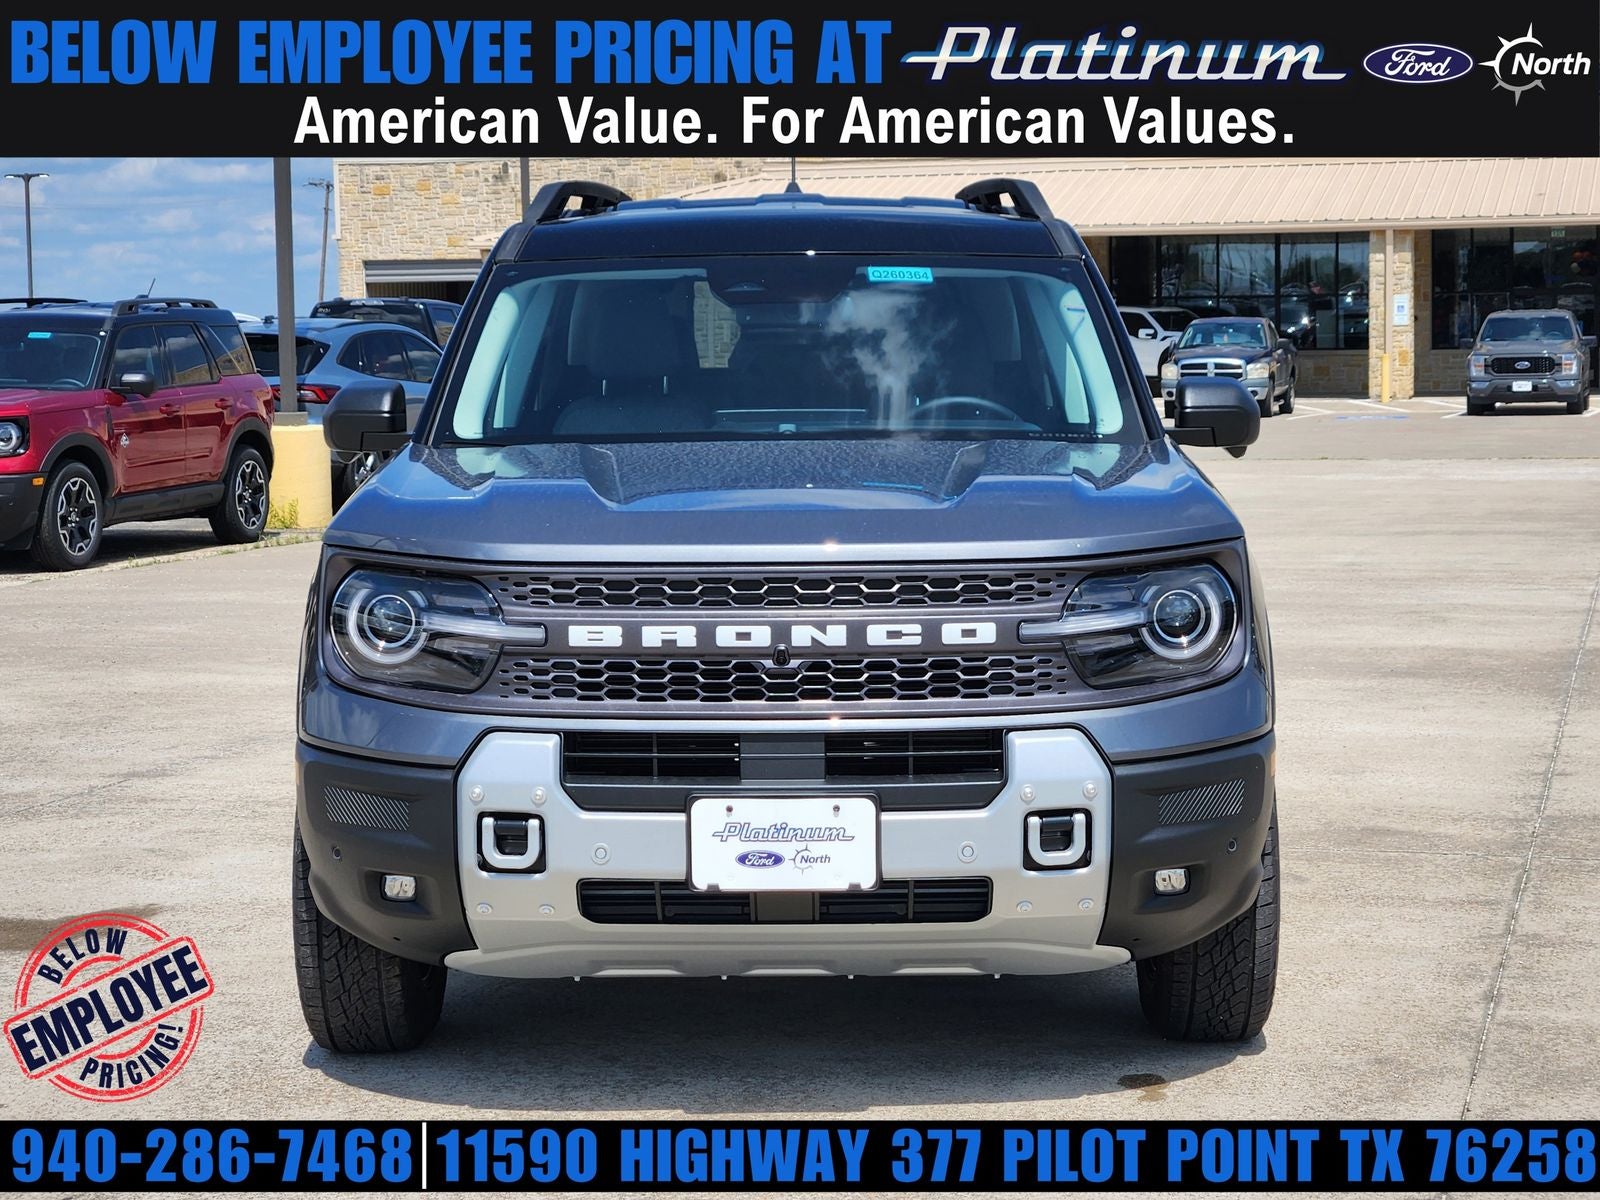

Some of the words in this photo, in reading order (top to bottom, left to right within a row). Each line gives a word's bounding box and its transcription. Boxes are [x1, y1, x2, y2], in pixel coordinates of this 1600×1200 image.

[871, 270, 929, 281] Q260364
[568, 622, 997, 648] BRONCO
[712, 822, 855, 843] Platinum
[745, 852, 775, 867] Ford
[799, 854, 831, 864] North
